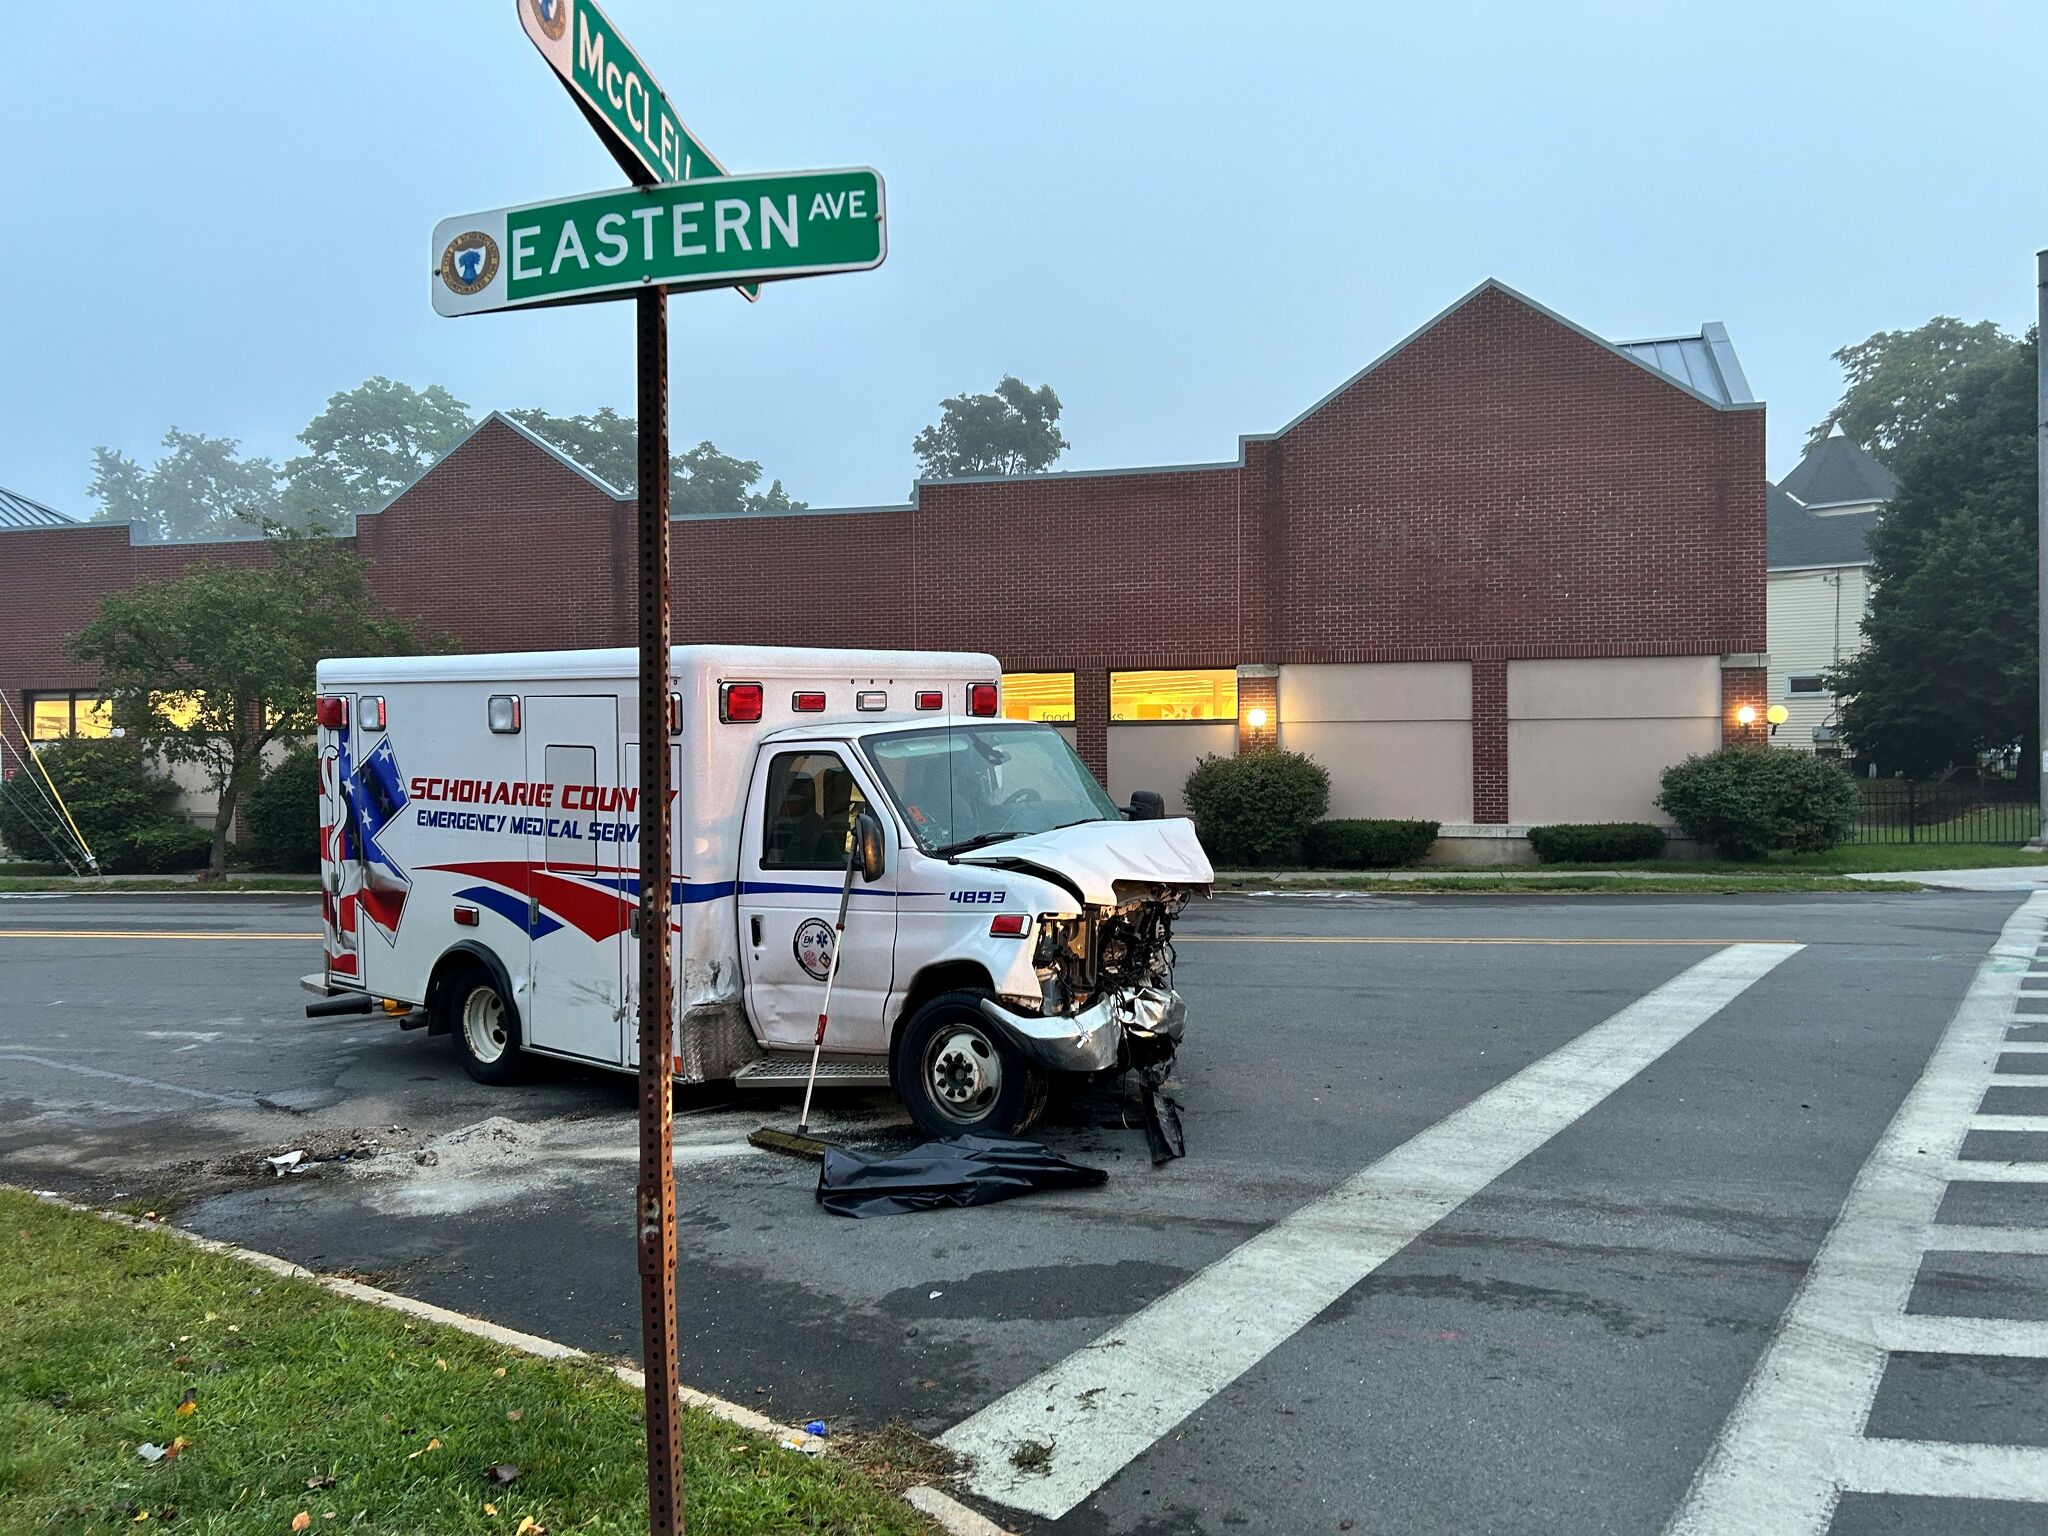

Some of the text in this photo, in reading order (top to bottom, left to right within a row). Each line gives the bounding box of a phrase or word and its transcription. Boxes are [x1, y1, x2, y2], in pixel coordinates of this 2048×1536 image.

[512, 190, 867, 281] EASTERN AVE
[410, 777, 679, 812] SCHOHARIE COUN
[416, 809, 640, 843] EMERGENCY MEDICAL SERV
[949, 891, 1006, 903] 4893
